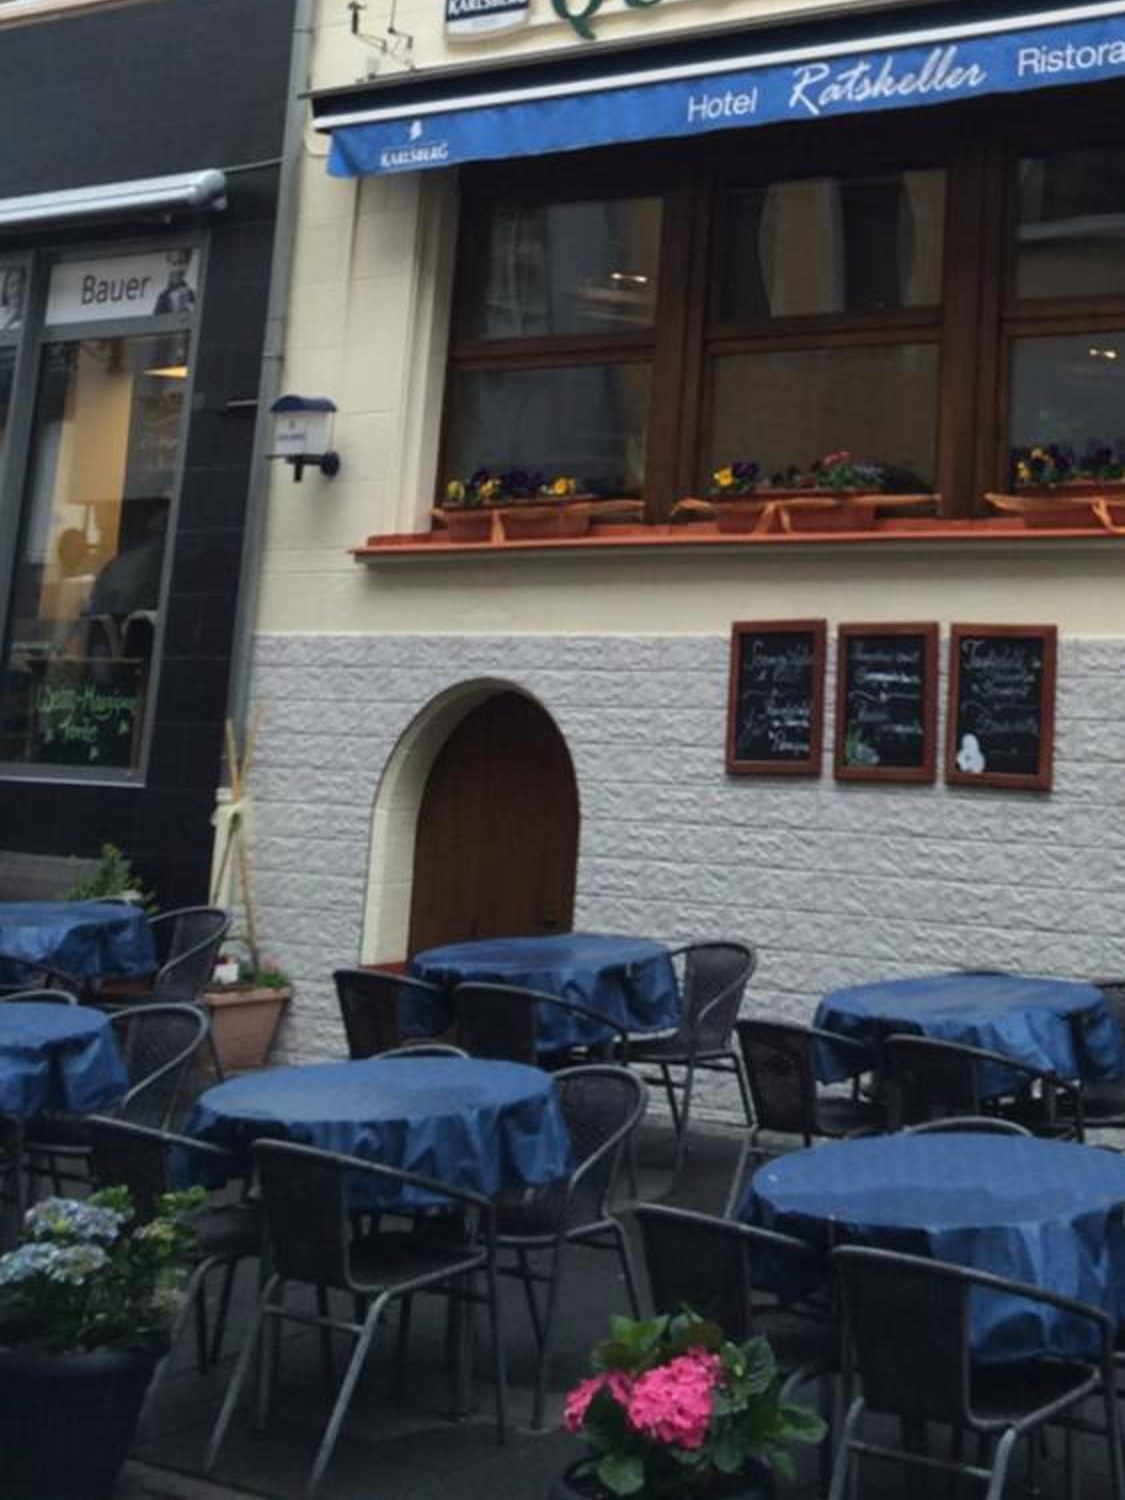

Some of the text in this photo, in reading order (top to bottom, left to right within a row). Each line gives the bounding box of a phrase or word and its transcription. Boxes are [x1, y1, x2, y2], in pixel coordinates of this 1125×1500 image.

[687, 88, 757, 122] Hotel
[788, 45, 987, 116] Ratskeller
[80, 275, 151, 306] Bauer
